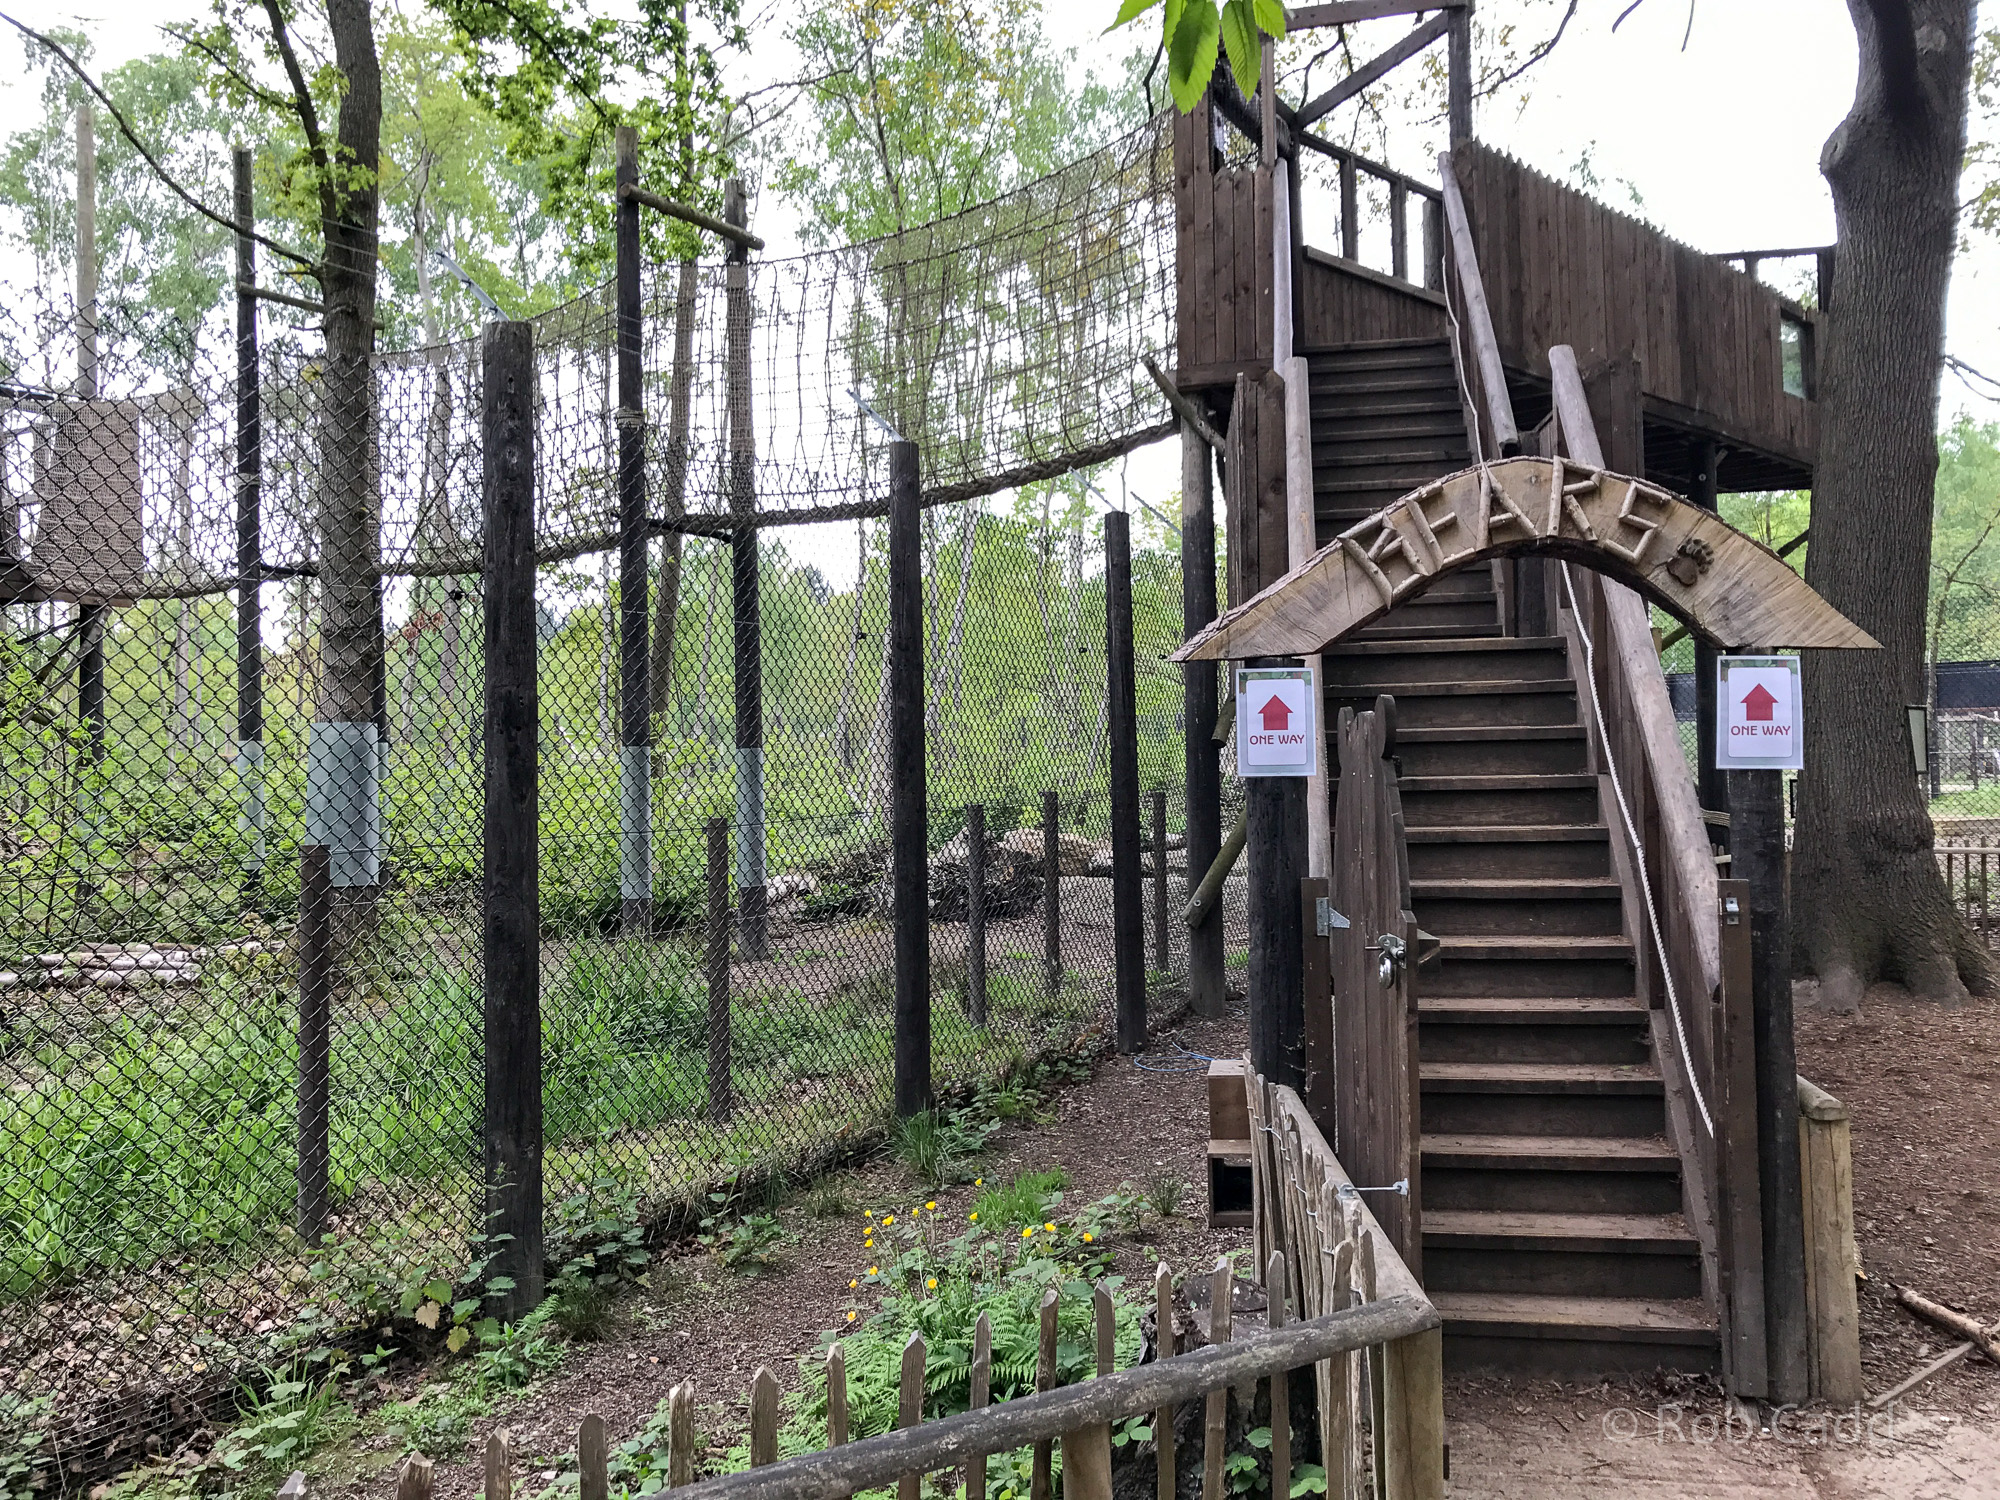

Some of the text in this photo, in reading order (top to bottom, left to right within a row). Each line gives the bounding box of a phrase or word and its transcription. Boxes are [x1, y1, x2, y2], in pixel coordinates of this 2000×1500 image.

[1339, 456, 1671, 608] BEARS
[1731, 726, 1791, 736] ONE WAY
[1249, 734, 1305, 745] ONE WAY
